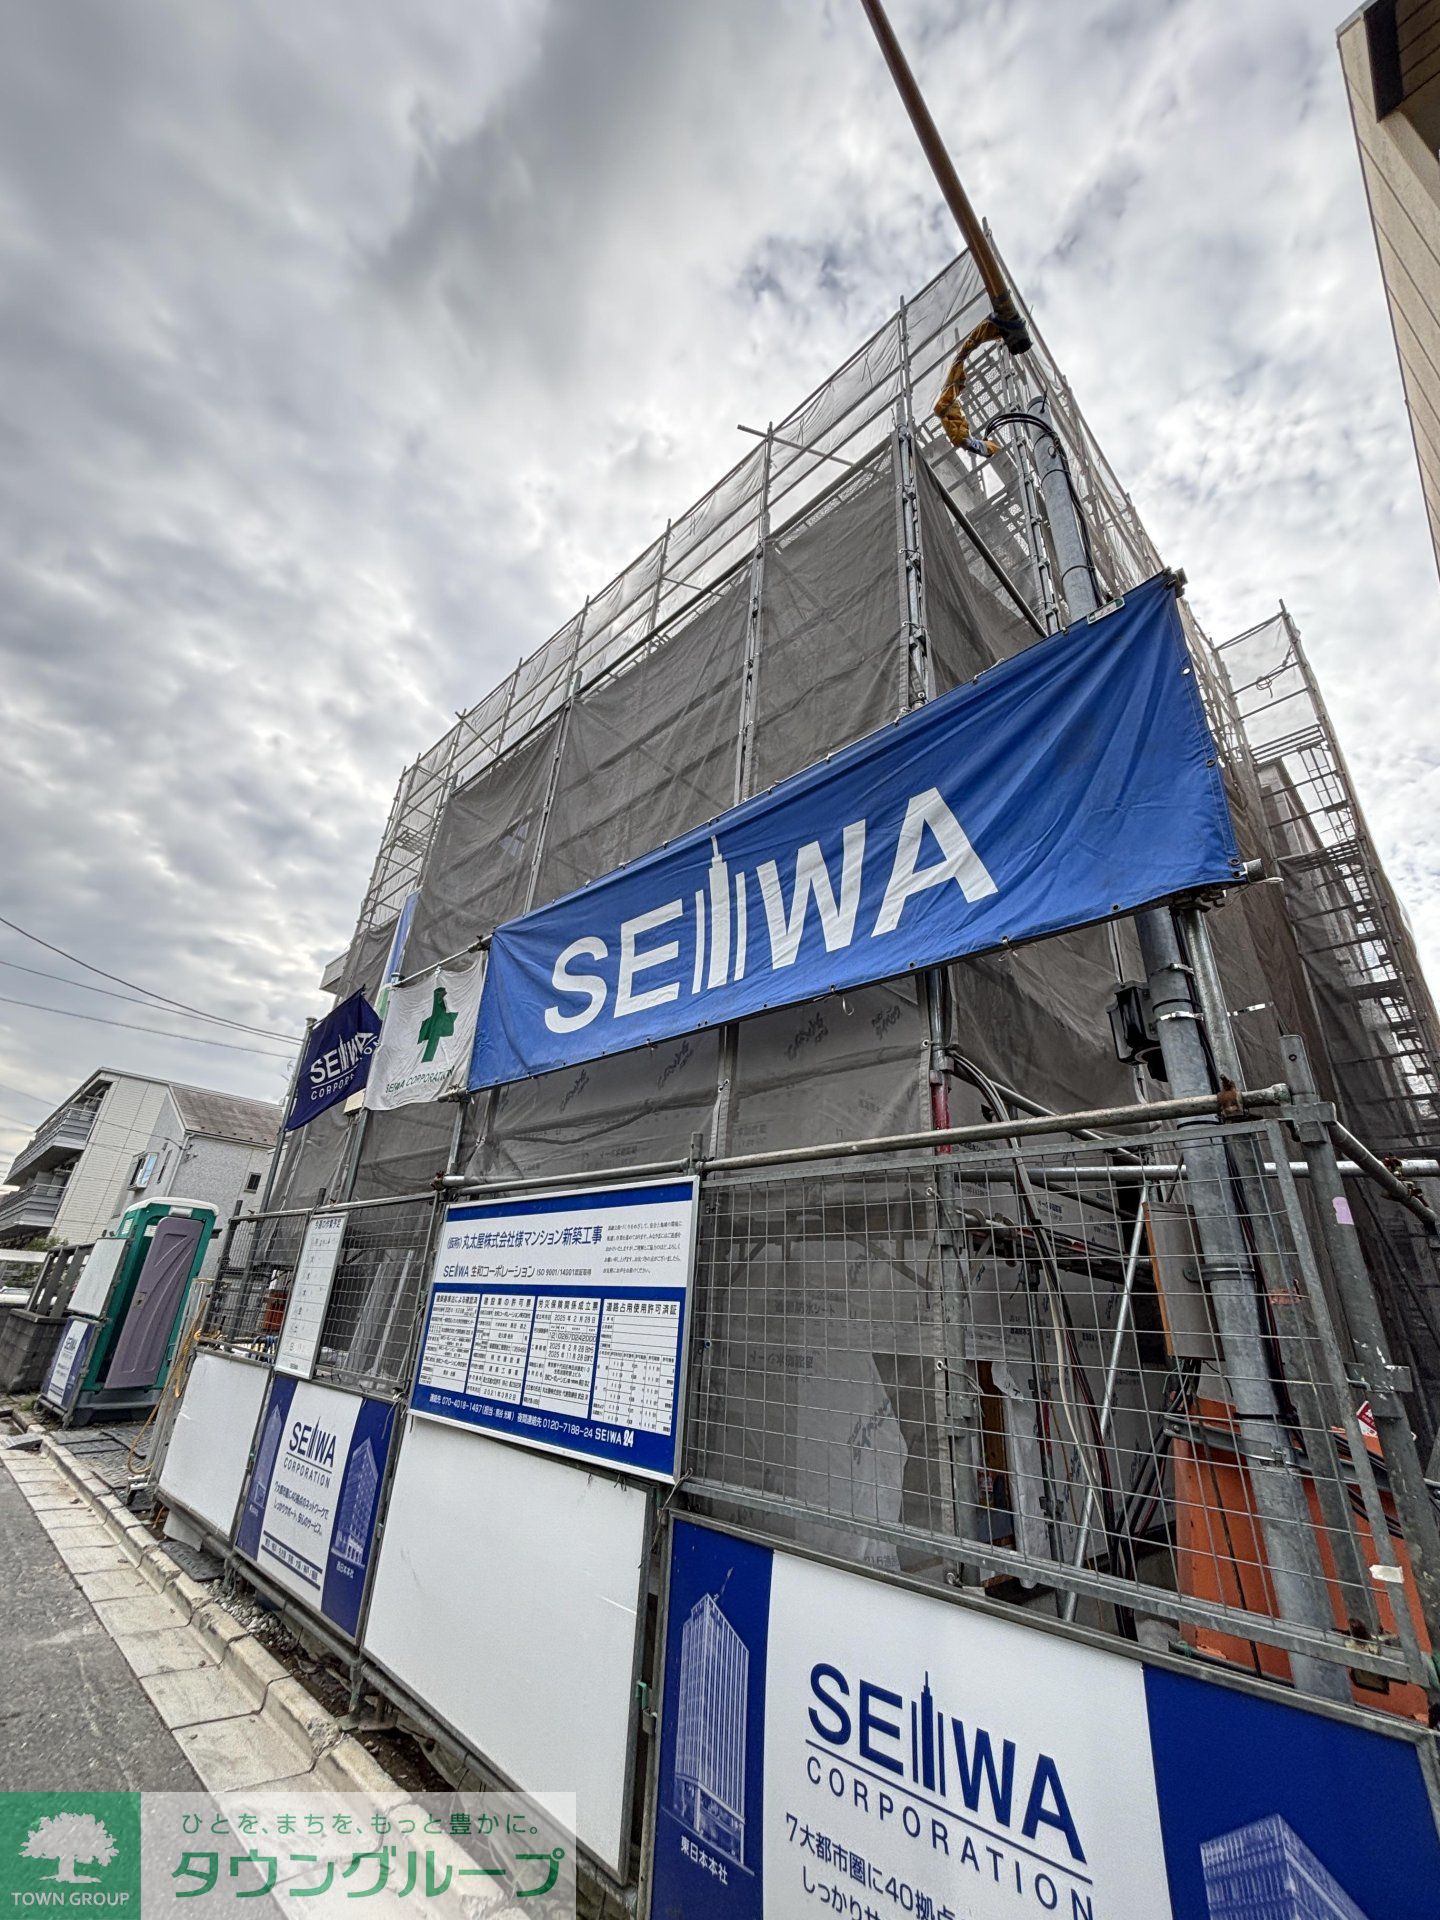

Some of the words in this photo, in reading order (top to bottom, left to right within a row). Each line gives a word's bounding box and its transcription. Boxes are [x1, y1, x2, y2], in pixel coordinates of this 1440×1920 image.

[544, 787, 998, 1035] SEIWA
[310, 1032, 374, 1084] SEIWA
[443, 1262, 469, 1278] SEIWA
[470, 1265, 536, 1278] 生和コーポレーション
[289, 1416, 337, 1468] SEIWA
[542, 1417, 593, 1439] 0120-7188-24
[595, 1428, 622, 1445] SEIWA
[283, 1457, 331, 1489] CORPORATION
[807, 1662, 1087, 1865] SEIWA
[680, 1834, 729, 1886] 東日本本社
[806, 1756, 1093, 1920] CORPORATION
